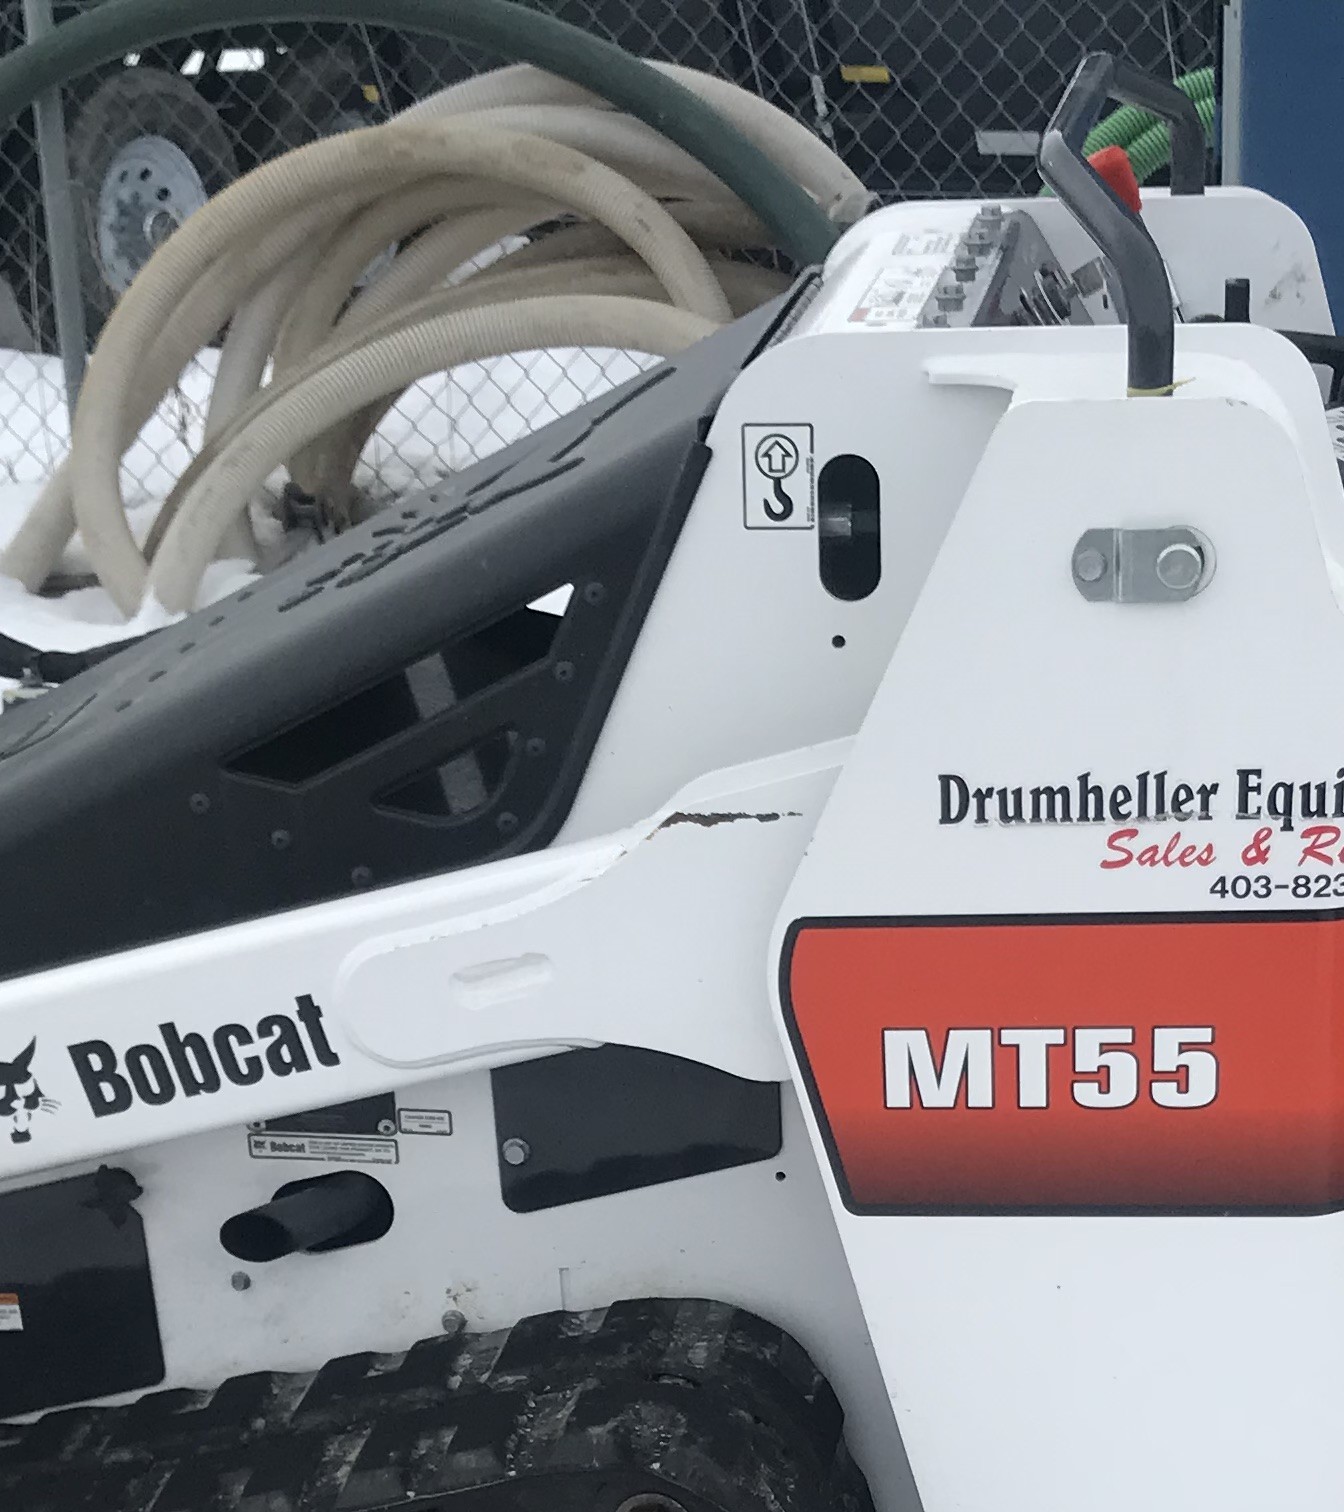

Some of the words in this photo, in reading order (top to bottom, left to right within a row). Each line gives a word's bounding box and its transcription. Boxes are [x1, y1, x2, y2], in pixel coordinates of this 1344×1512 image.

[938, 770, 1219, 827] Drumheller
[1100, 828, 1217, 870] Sales
[1241, 829, 1272, 867] &
[67, 994, 341, 1118] Bobcat
[882, 1026, 1219, 1109] MT55
[269, 1141, 306, 1154] Bobcat
